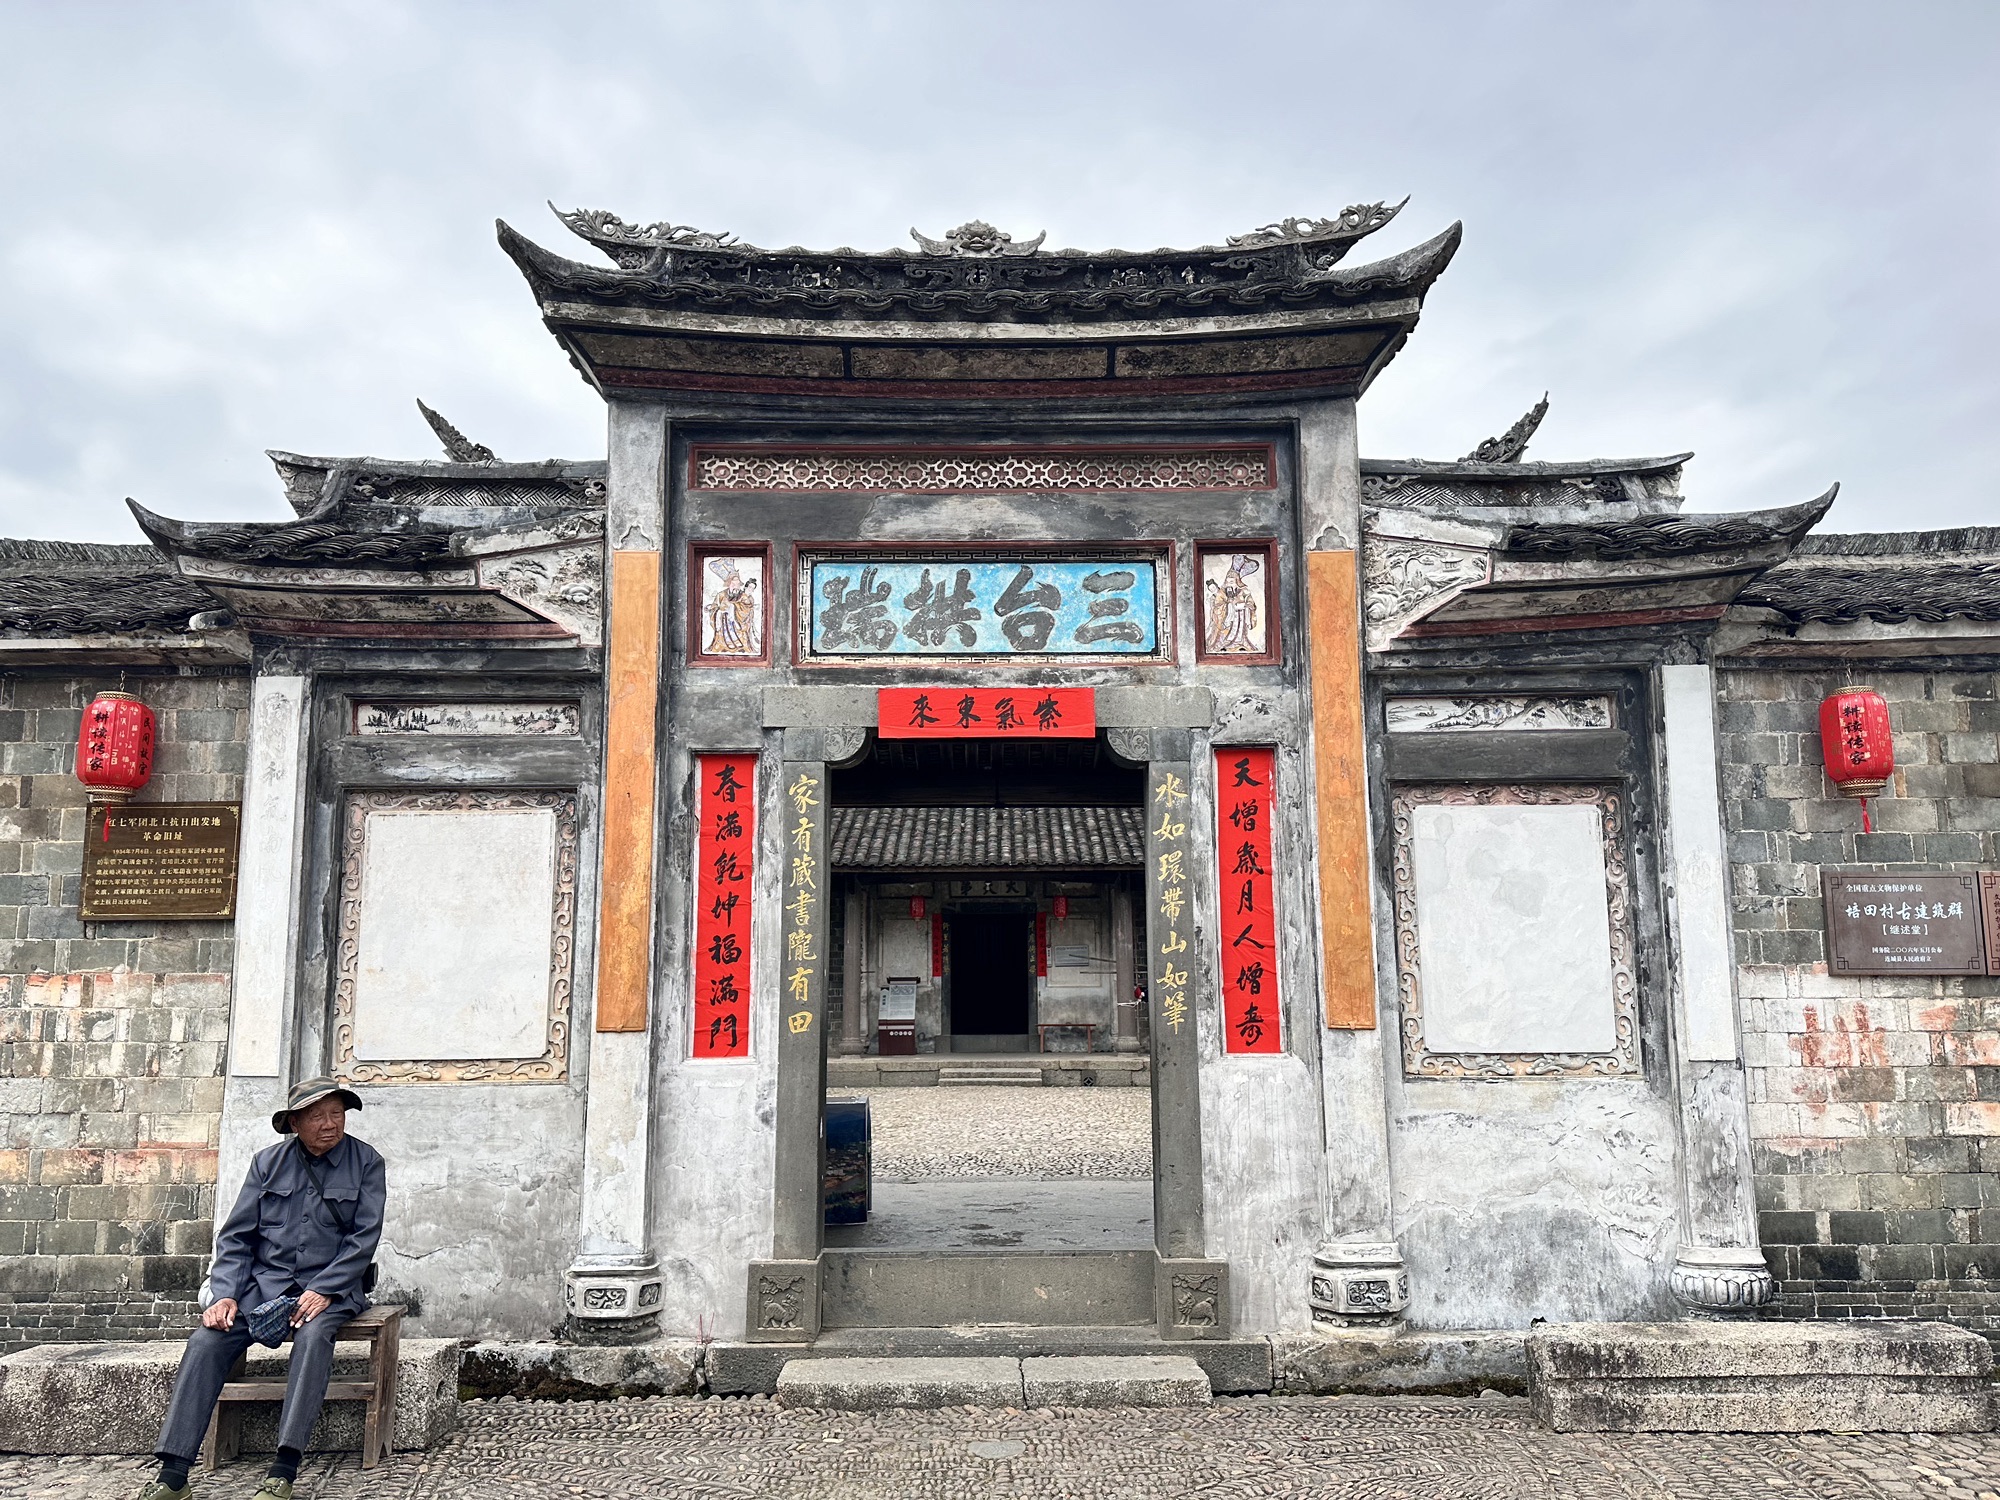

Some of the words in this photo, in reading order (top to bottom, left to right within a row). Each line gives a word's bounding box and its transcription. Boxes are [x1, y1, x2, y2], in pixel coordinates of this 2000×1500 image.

[142, 831, 184, 842] 革命旧址
[1845, 884, 1924, 893] 全国重点文物保护单位
[1845, 901, 1964, 921] 培田村古建筑群
